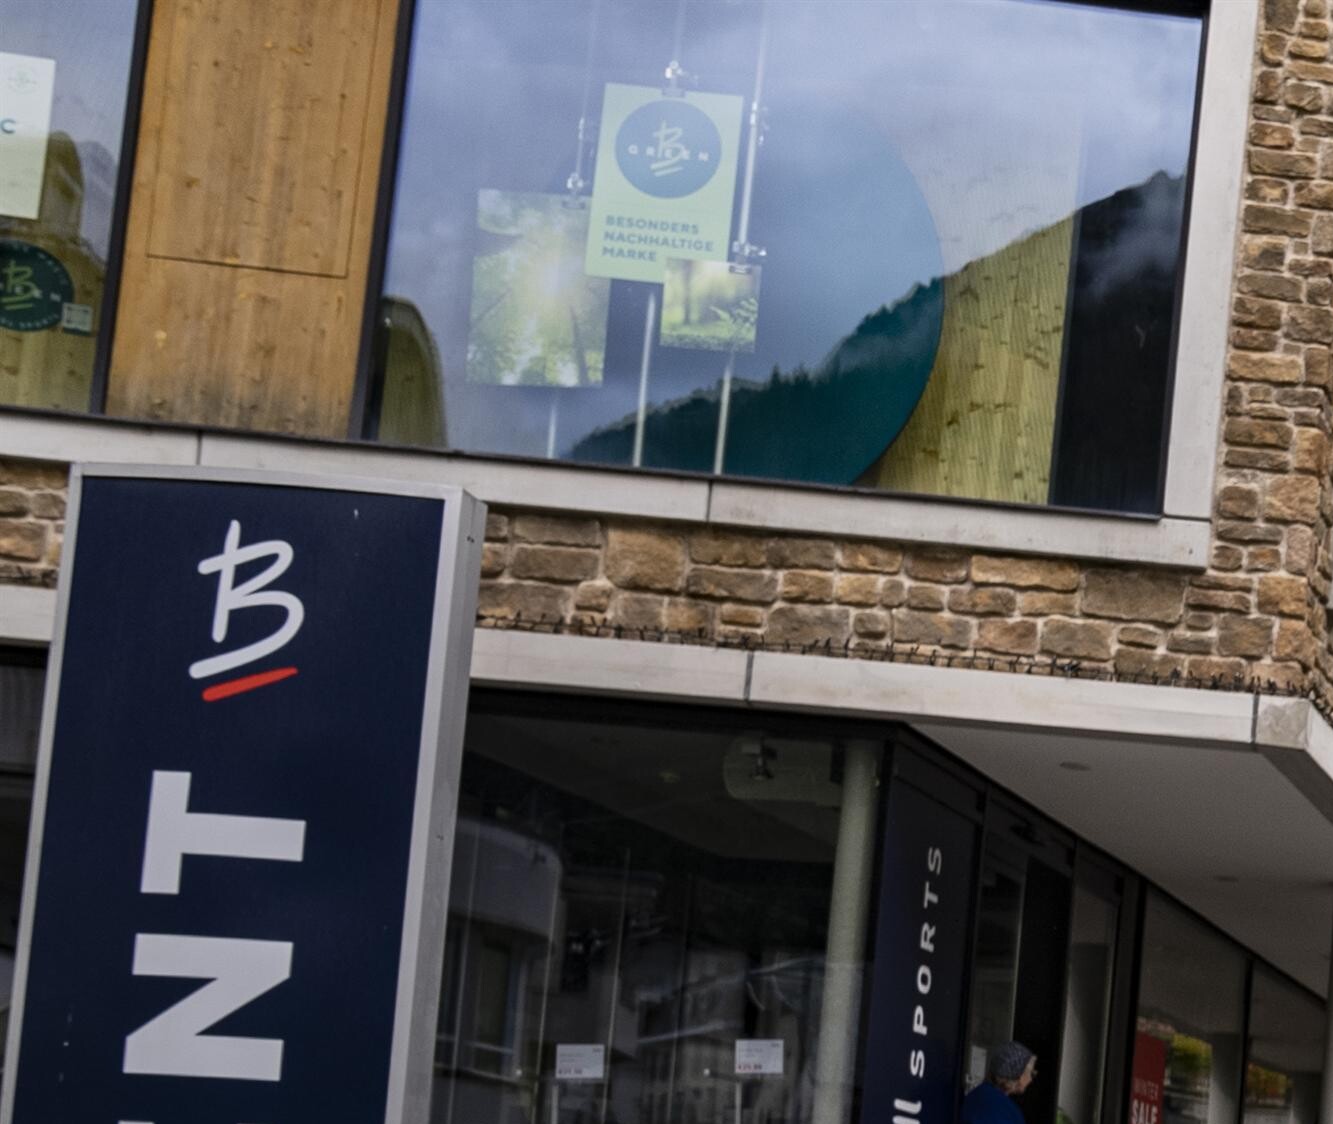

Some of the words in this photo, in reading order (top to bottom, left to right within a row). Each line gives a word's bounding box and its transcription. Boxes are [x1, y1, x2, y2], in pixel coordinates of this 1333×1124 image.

[605, 214, 700, 235] BESONDERS
[603, 231, 715, 252] NACHHALTIGE
[601, 246, 658, 263] MARKE
[188, 519, 305, 681] B
[909, 846, 943, 1080] SPORTS
